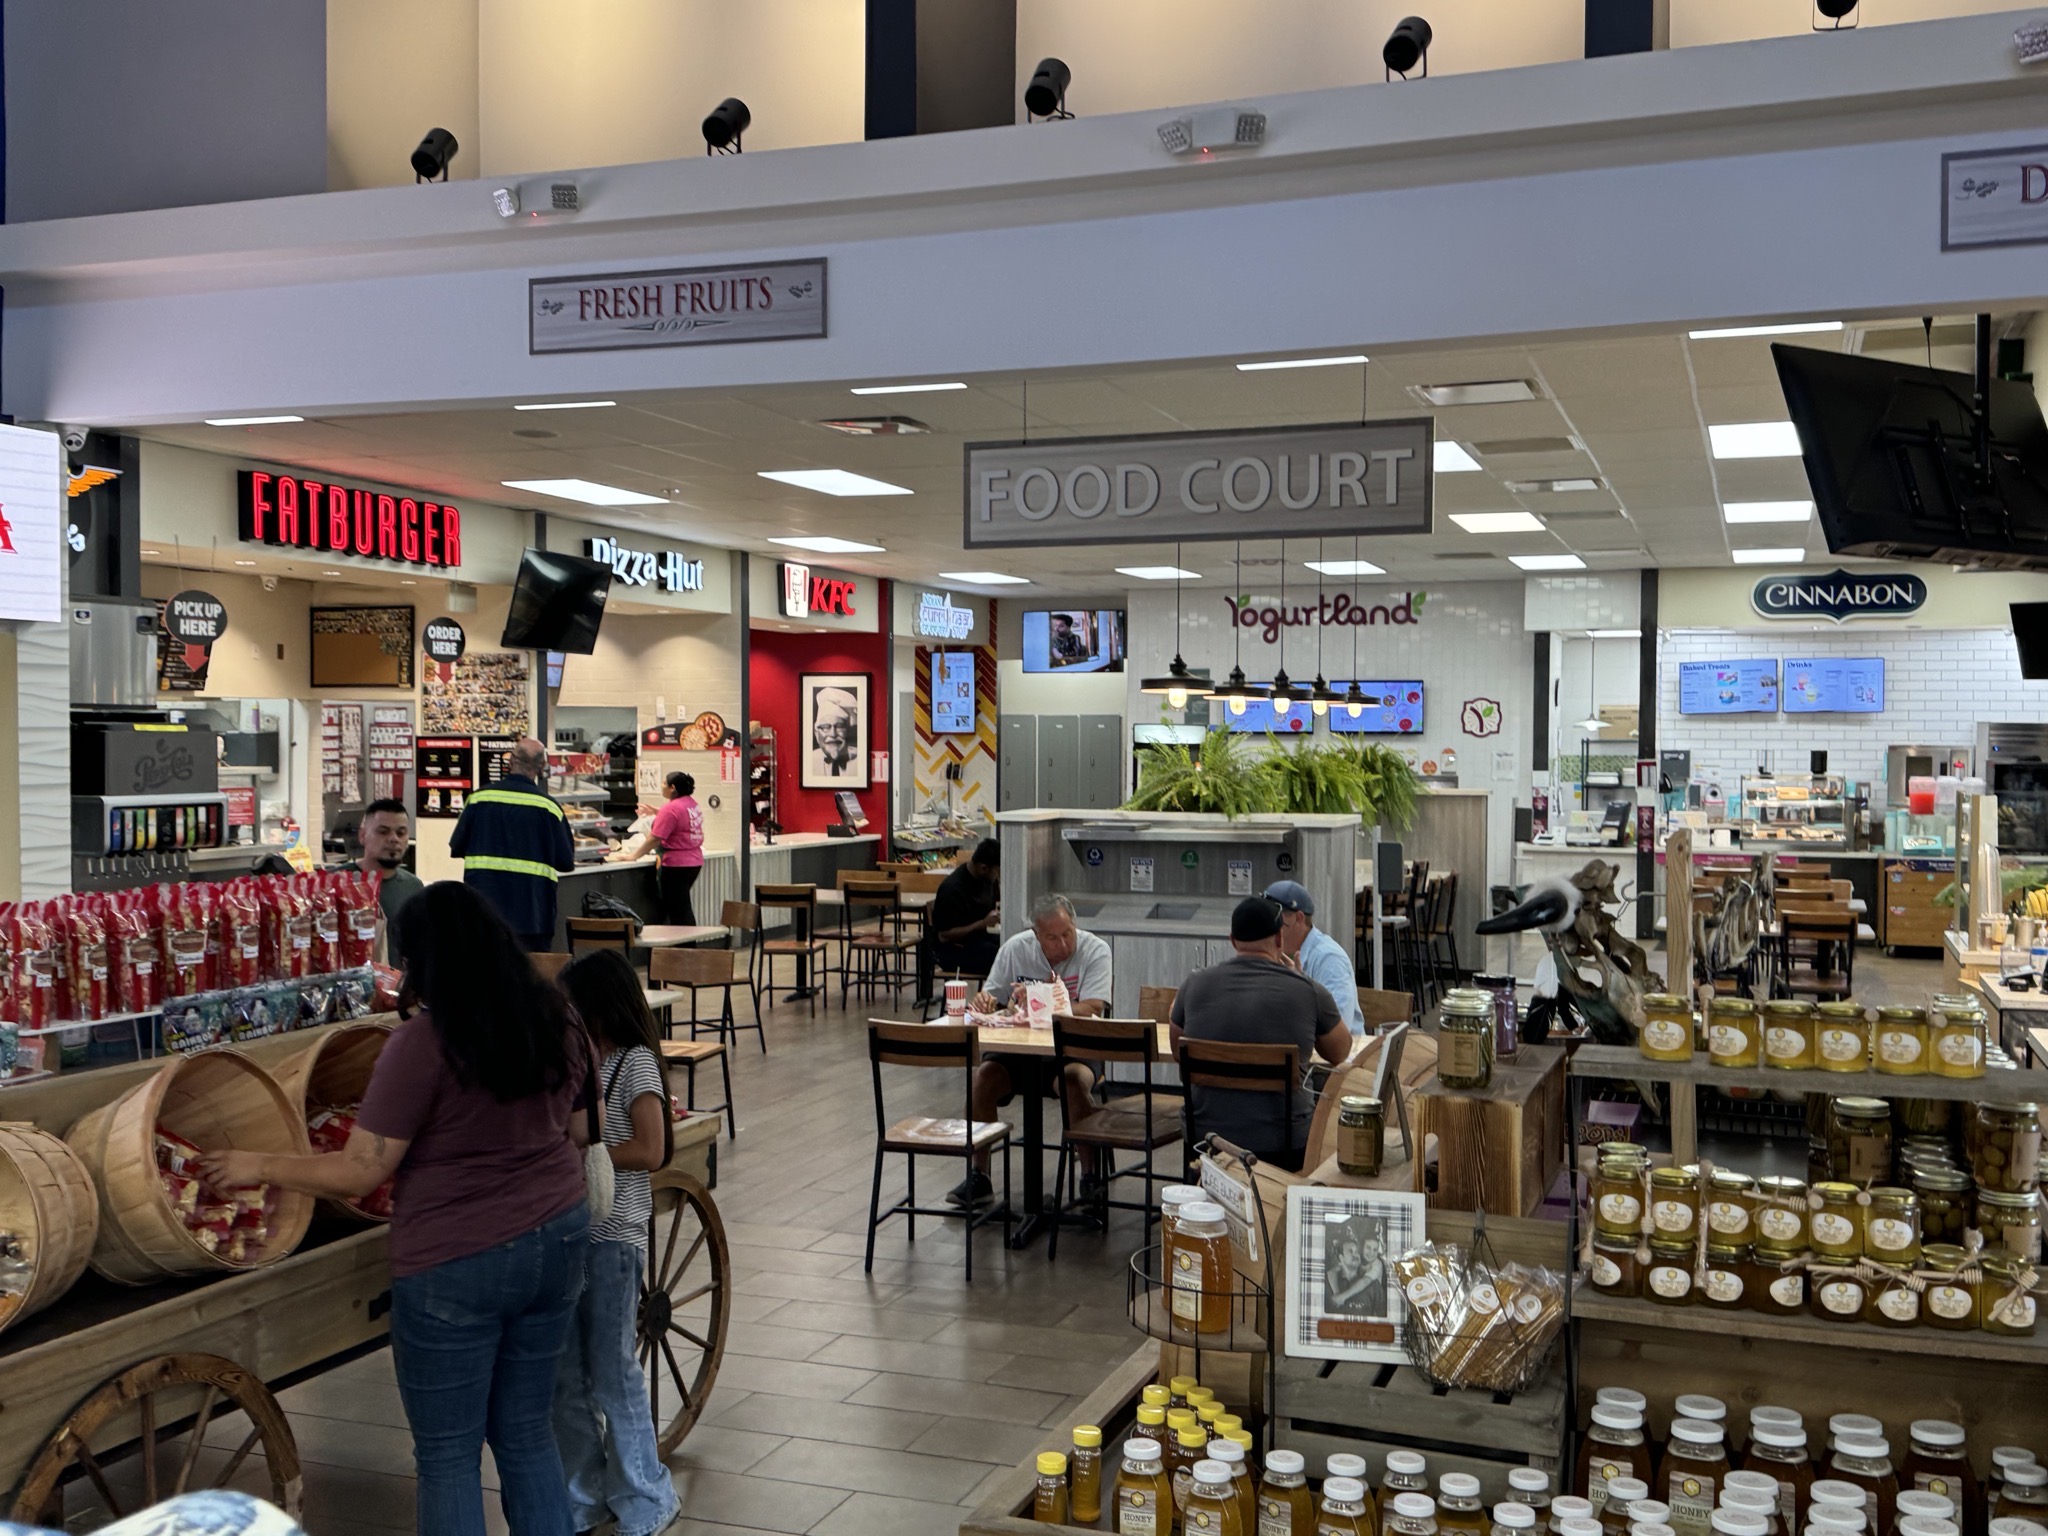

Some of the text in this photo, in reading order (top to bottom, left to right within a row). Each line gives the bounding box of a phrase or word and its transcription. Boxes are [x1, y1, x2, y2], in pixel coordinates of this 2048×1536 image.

[579, 276, 773, 321] FRESH FRUITS
[979, 447, 1414, 522] FOOD COURT
[253, 471, 461, 567] FATBURGER
[592, 537, 704, 593] Pizza Hut
[810, 577, 856, 616] KFC
[1765, 583, 1913, 608] CINNABON
[174, 600, 222, 618] PICK UP
[1224, 592, 1418, 644] Yogurtland
[180, 619, 216, 636] HERE
[427, 625, 461, 641] ORDER
[432, 641, 457, 655] HERE
[1124, 1513, 1153, 1523] HONEY
[1672, 1503, 1711, 1518] HONEY
